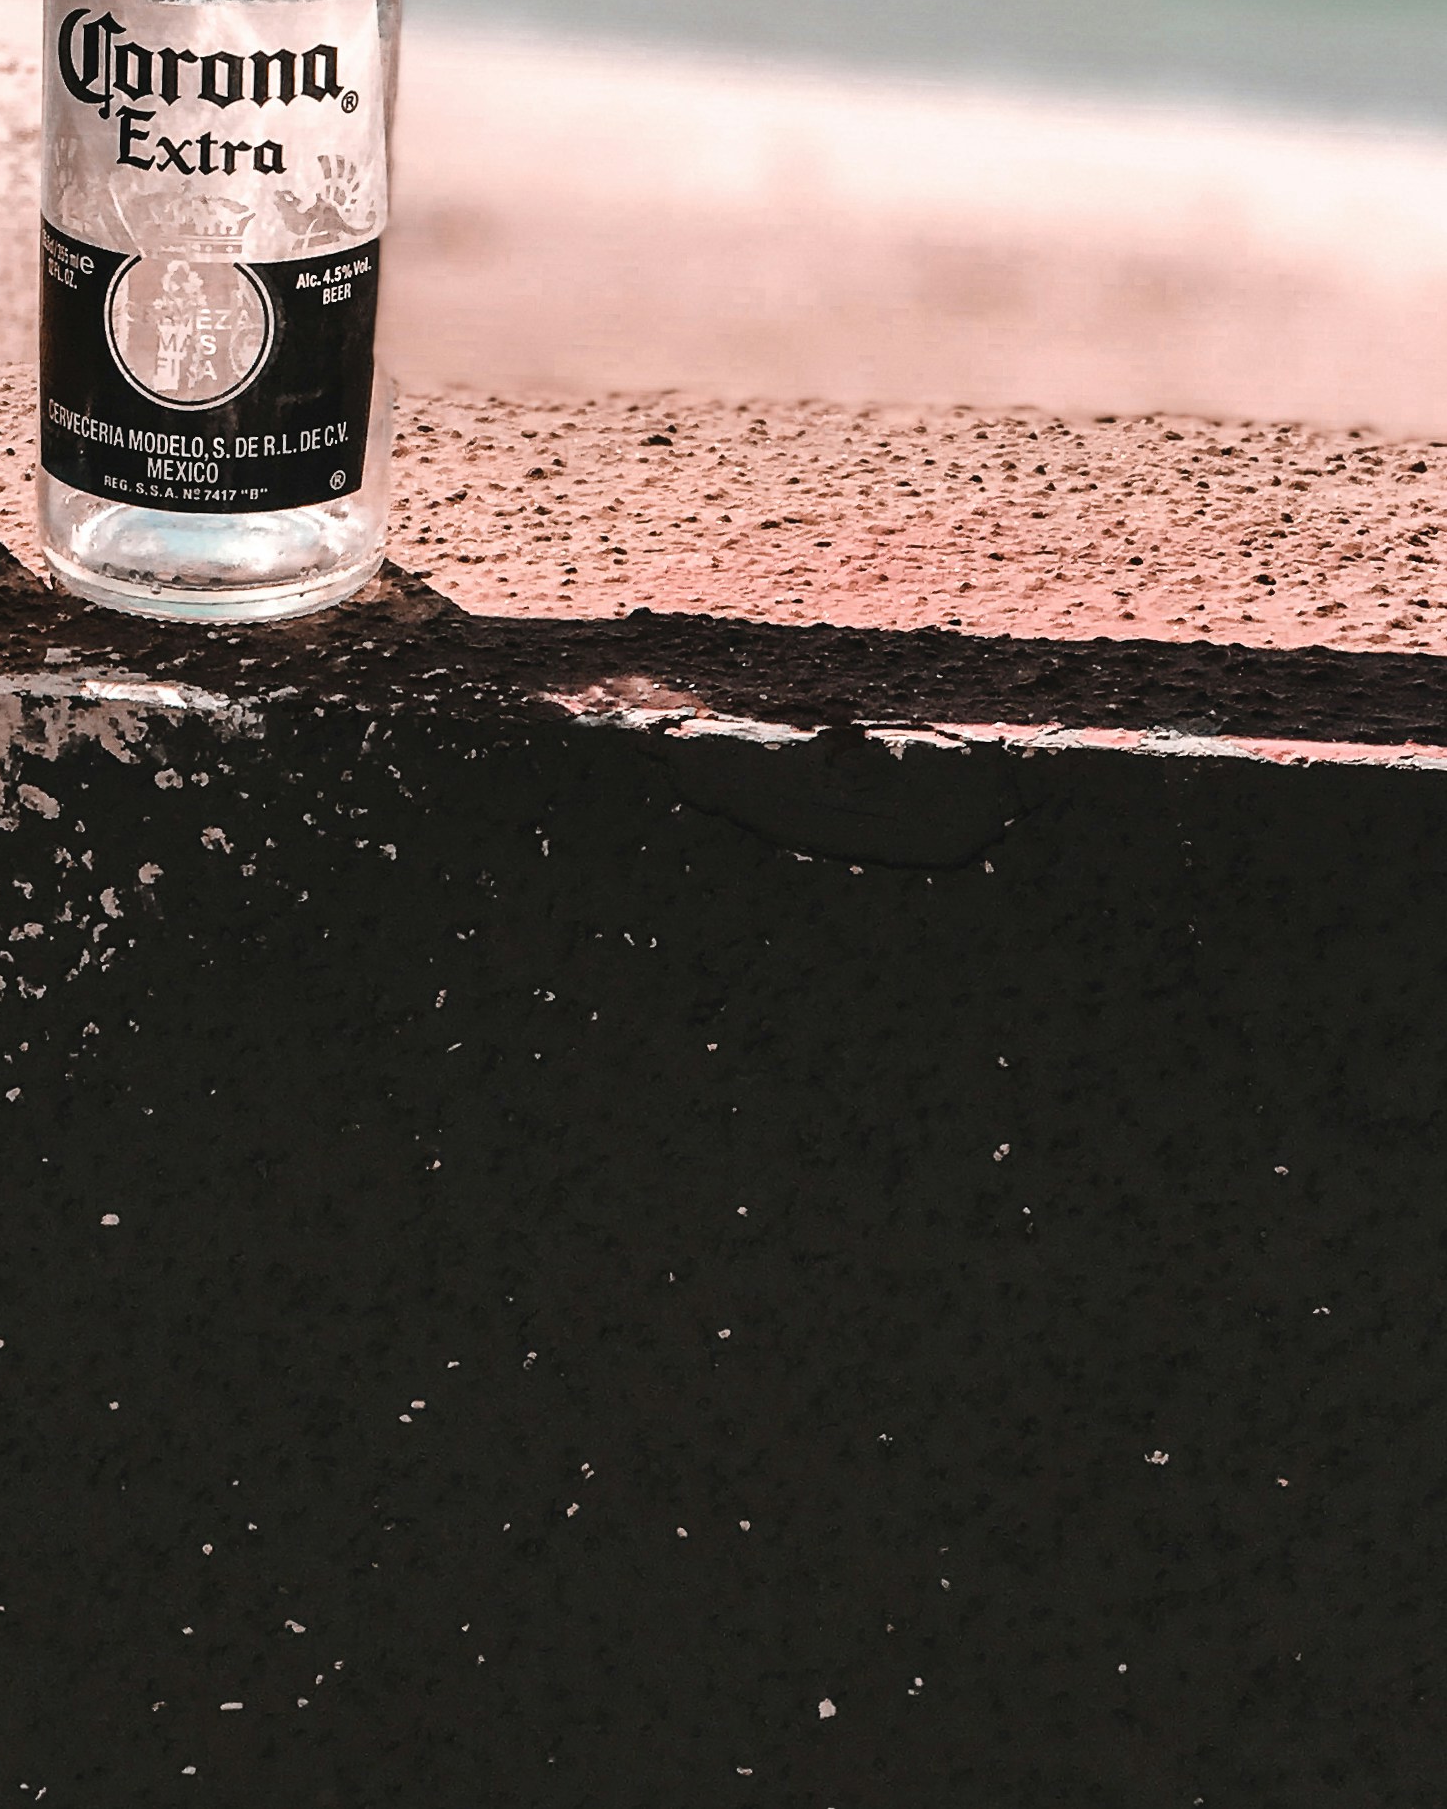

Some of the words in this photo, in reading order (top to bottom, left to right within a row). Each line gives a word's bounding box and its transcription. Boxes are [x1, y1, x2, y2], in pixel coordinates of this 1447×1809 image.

[58, 8, 345, 120] Corona
[115, 105, 288, 176] Extra
[295, 272, 322, 289] Alc.
[322, 263, 353, 284] 4.5%
[353, 256, 372, 276] Vol.
[322, 282, 352, 305] BEER
[48, 398, 125, 448] CERVECERIA
[128, 429, 210, 461] MODELO,
[212, 437, 231, 459] S.
[235, 436, 259, 458] DE
[263, 434, 297, 457] R.L.
[300, 428, 321, 452] DE
[324, 421, 349, 446] C.V.
[147, 457, 219, 484] MEXICO
[104, 475, 132, 492] REG.
[204, 489, 237, 501] 7417
